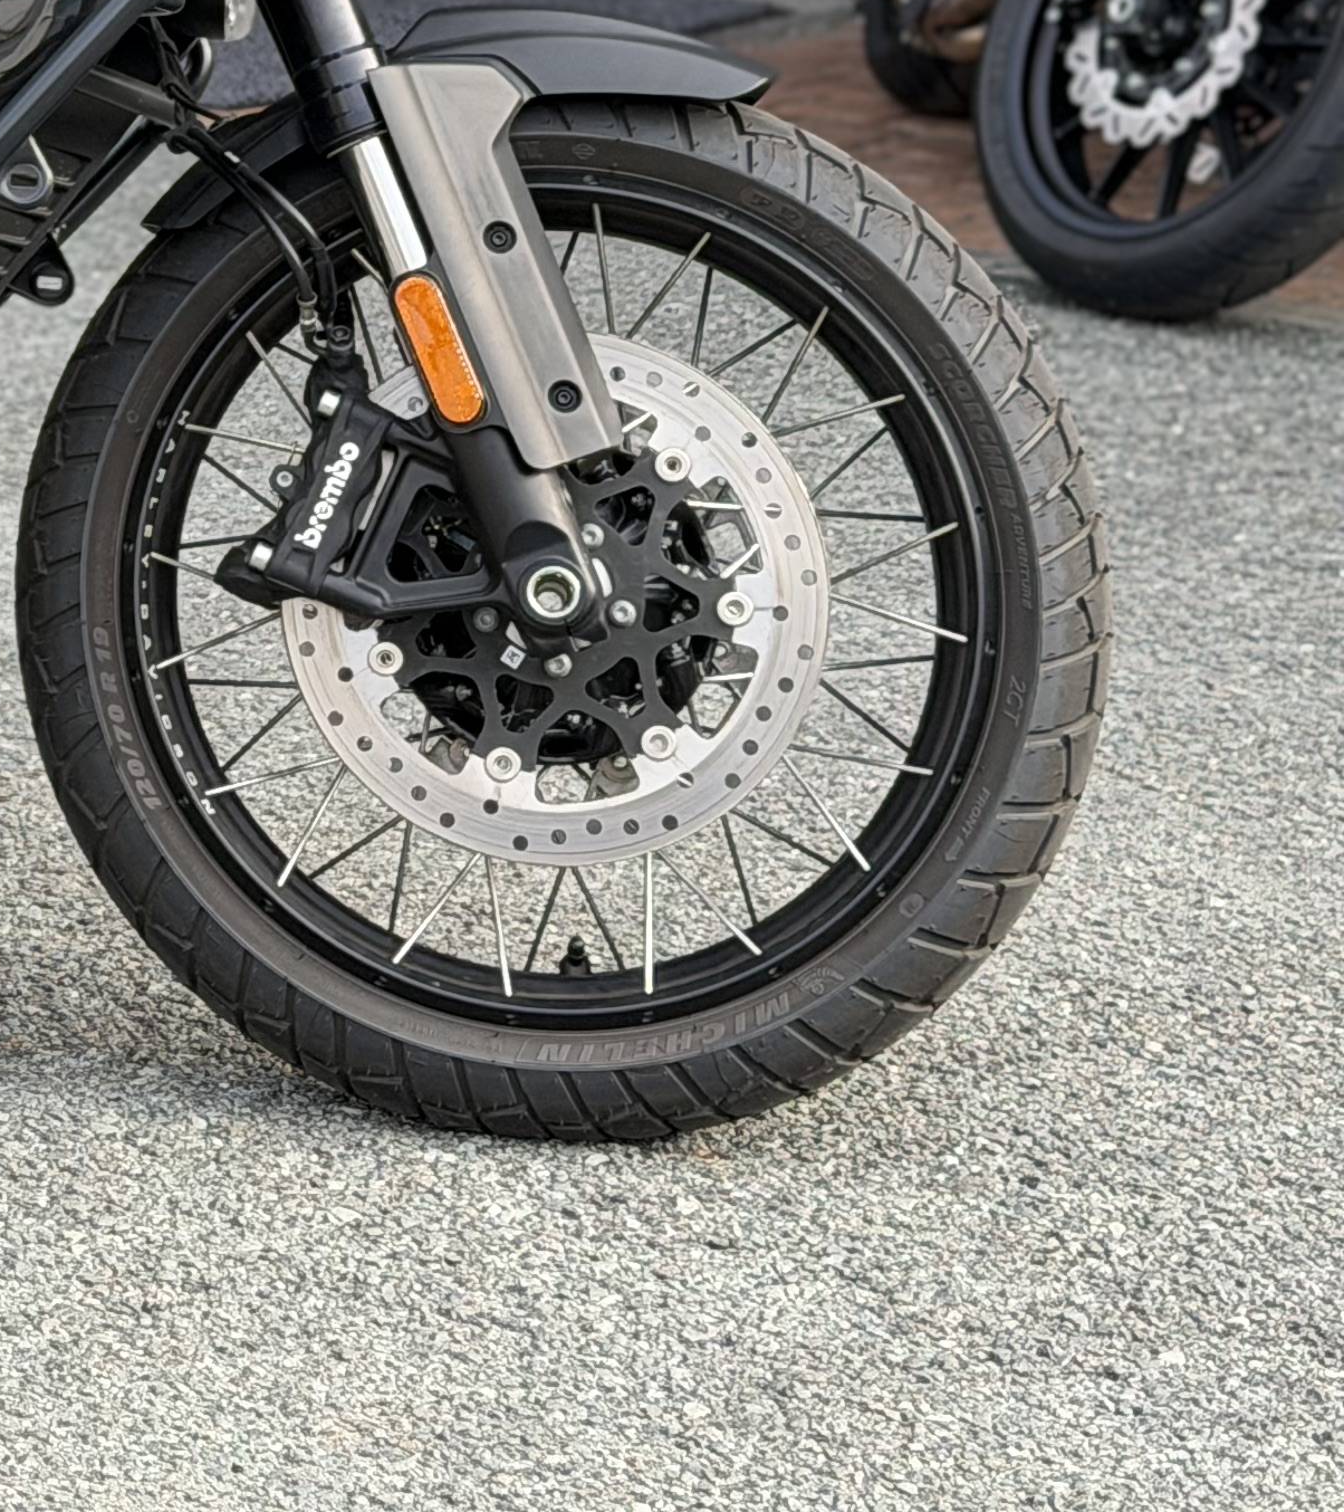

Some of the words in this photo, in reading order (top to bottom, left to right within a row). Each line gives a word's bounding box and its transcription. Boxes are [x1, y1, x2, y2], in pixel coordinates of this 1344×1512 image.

[294, 441, 360, 549] brembo
[92, 625, 112, 660] 19
[139, 409, 216, 816] HARLEY-DAVIDSON
[99, 670, 119, 694] R
[1003, 674, 1026, 728] 2CT
[107, 702, 162, 812] 120/70
[961, 787, 991, 839] FRONT
[536, 996, 792, 1064] MICHELIN
